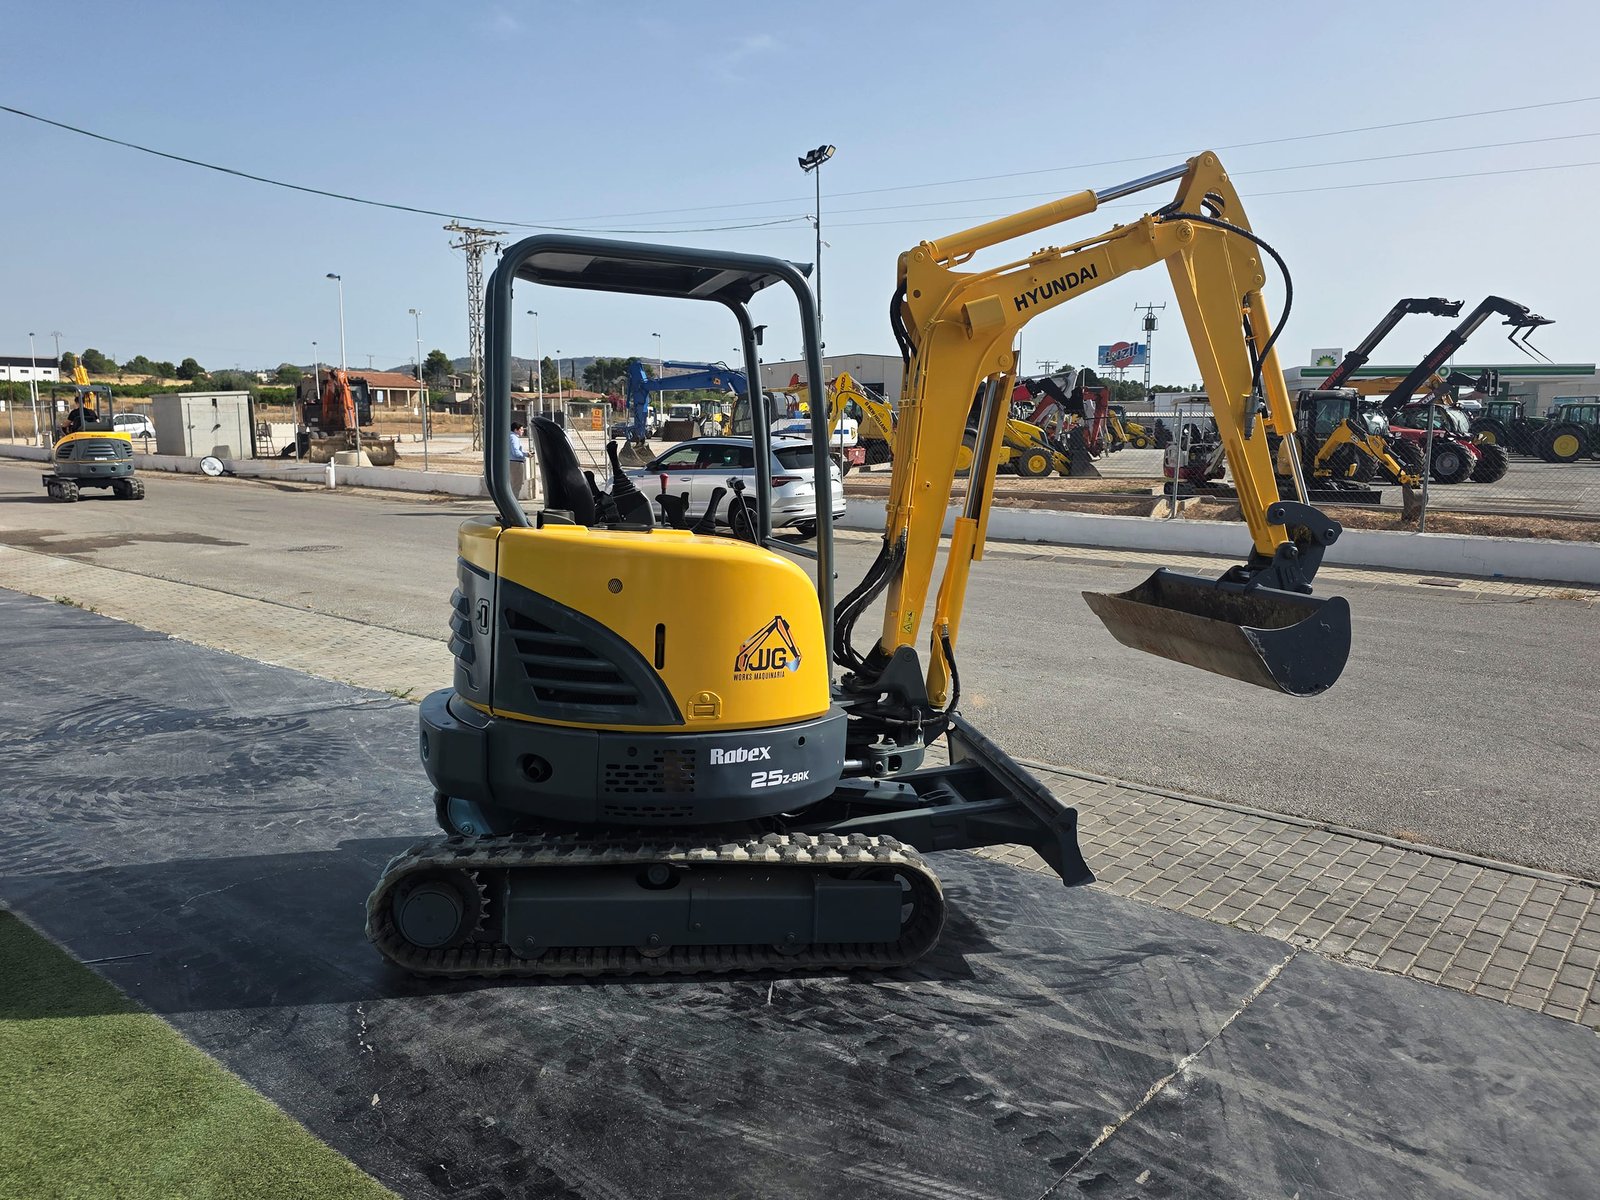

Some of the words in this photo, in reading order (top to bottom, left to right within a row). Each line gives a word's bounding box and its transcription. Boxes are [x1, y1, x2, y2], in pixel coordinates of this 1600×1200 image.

[1013, 263, 1098, 312] HYUNDAI
[1320, 364, 1344, 390] ANITOU
[733, 673, 753, 681] WORKS
[753, 670, 785, 680] MAQUINARIA
[710, 746, 771, 765] Robex
